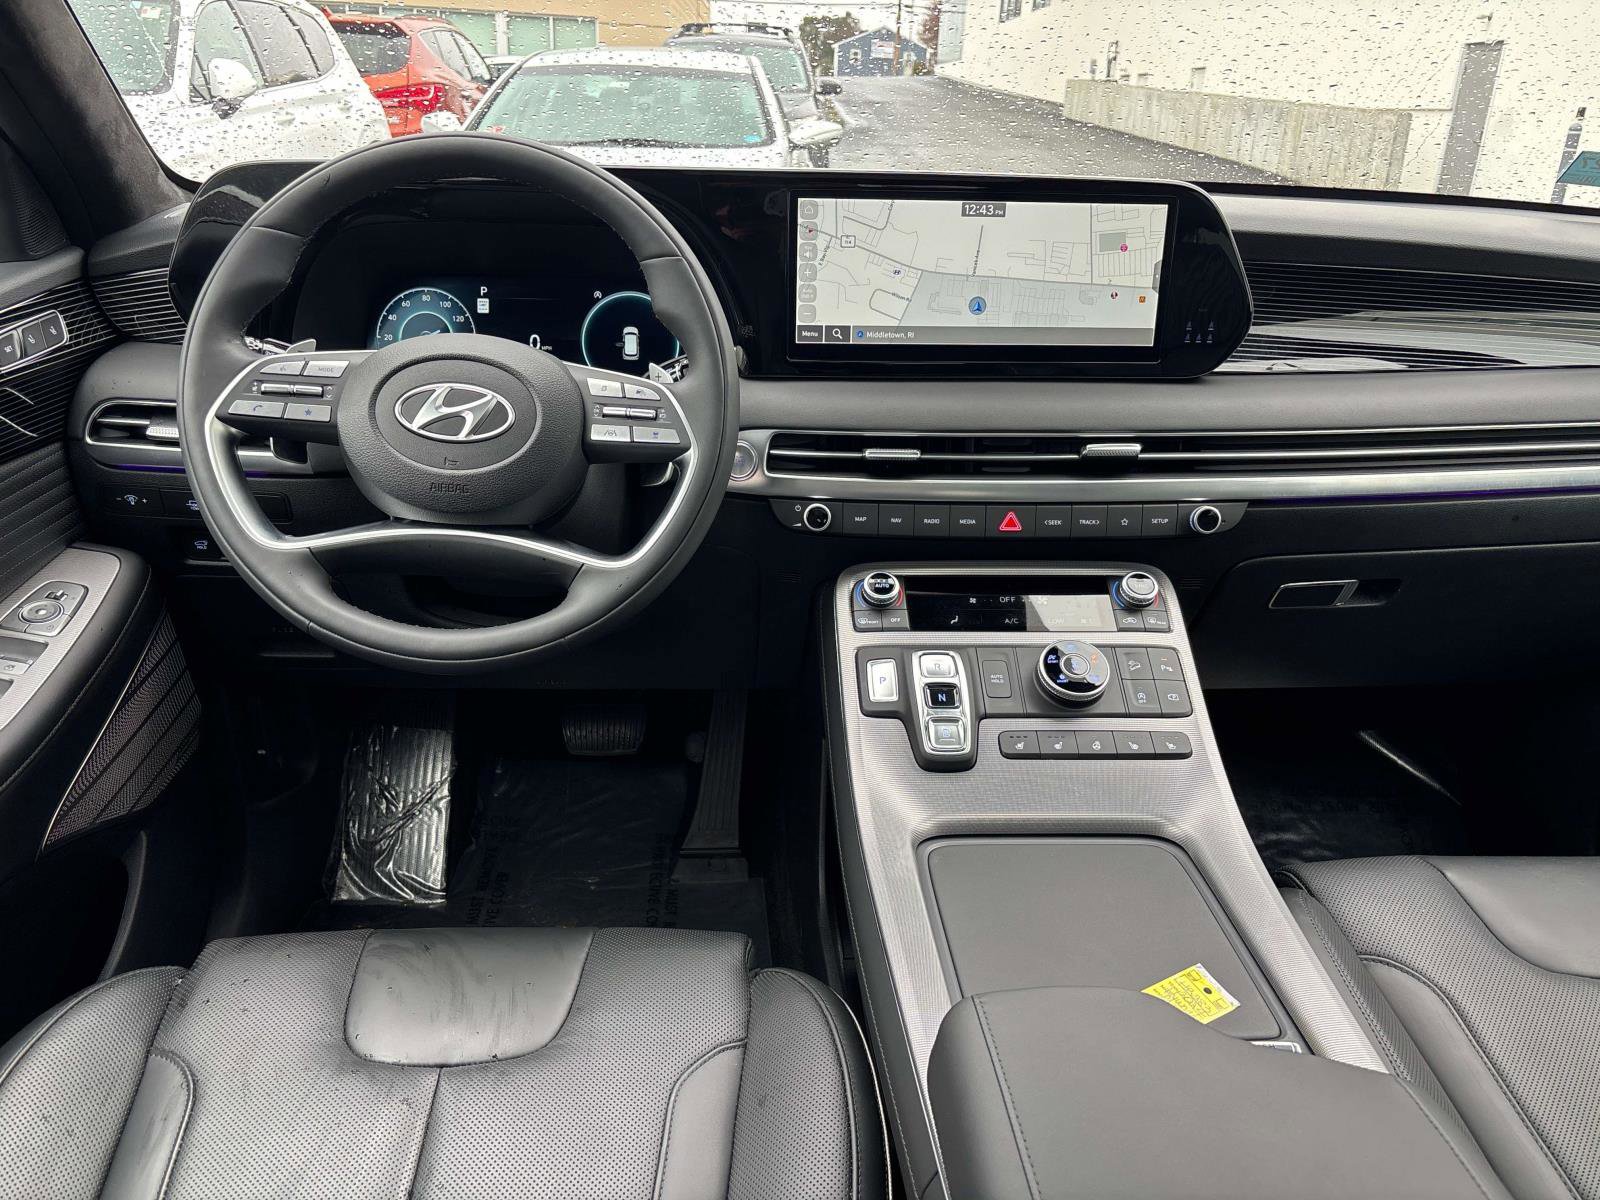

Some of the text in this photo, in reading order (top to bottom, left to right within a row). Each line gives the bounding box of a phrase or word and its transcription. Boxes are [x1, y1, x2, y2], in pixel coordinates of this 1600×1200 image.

[964, 204, 994, 215] 12:43
[480, 286, 488, 297] P
[401, 300, 411, 308] 60
[439, 301, 451, 309] 100
[452, 315, 465, 323] 120
[866, 330, 906, 340] Middletown,
[529, 334, 541, 350] 0
[429, 481, 470, 495] AIRBAG
[879, 676, 887, 685] P
[938, 693, 947, 702] N
